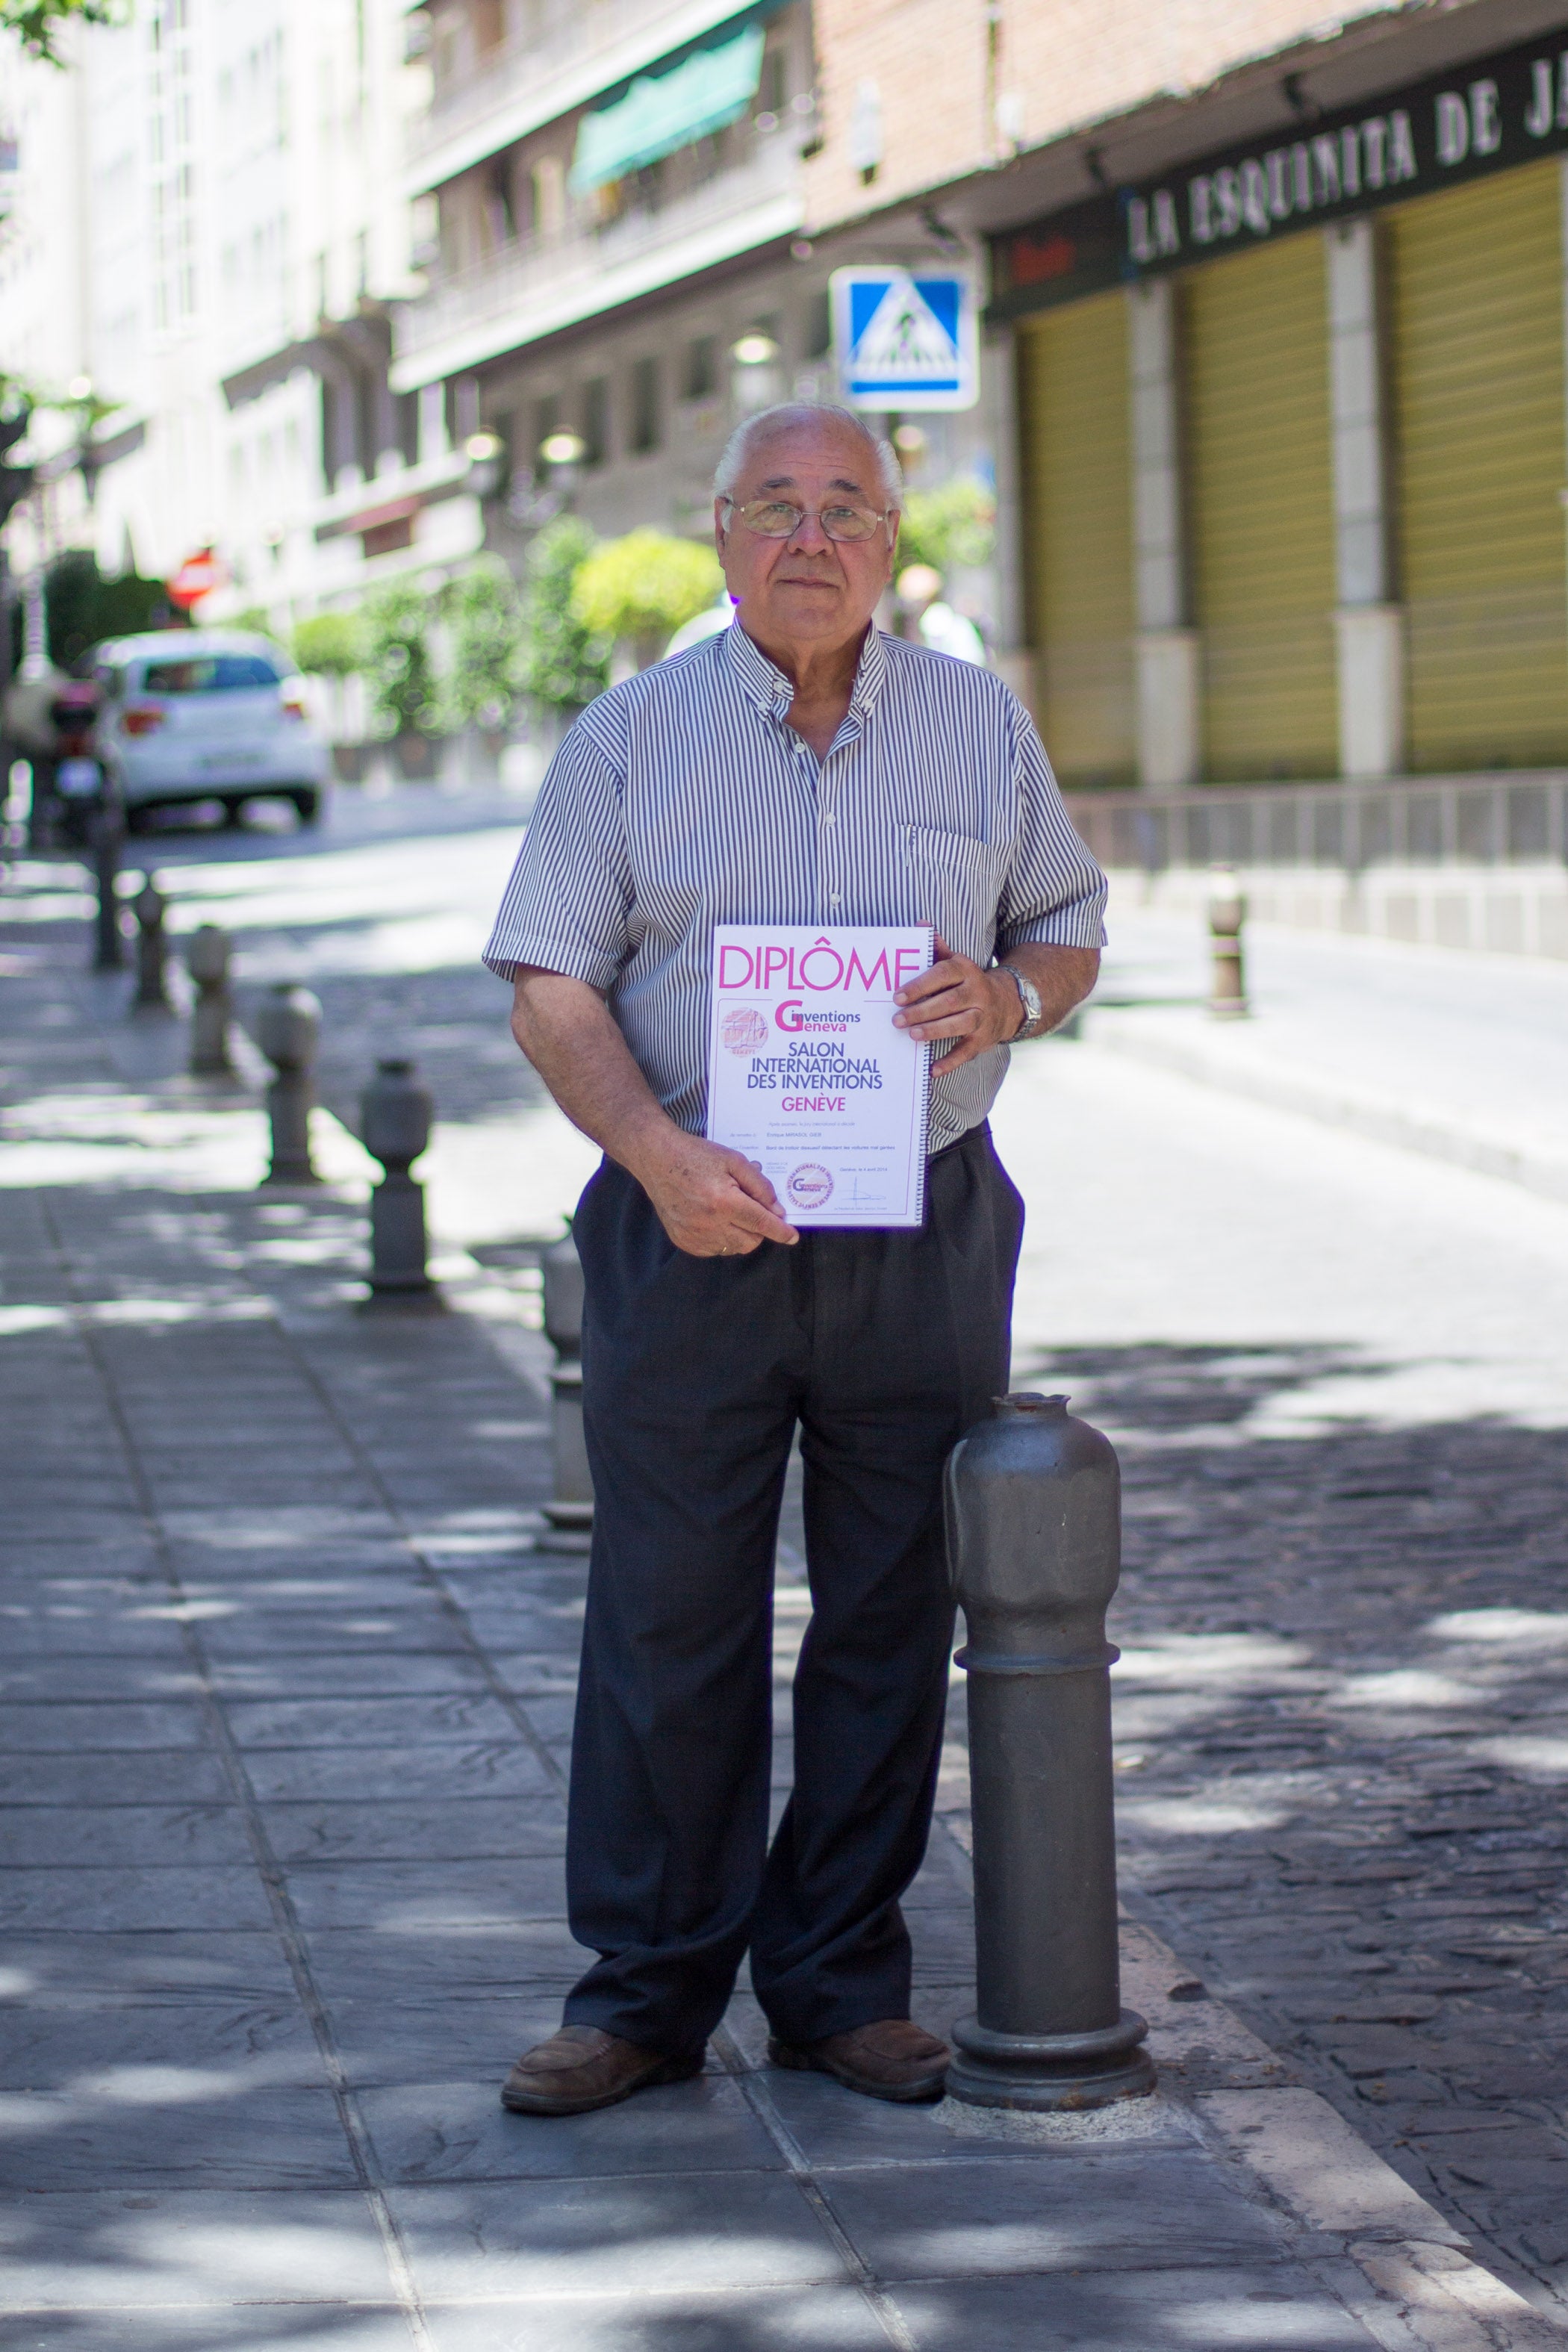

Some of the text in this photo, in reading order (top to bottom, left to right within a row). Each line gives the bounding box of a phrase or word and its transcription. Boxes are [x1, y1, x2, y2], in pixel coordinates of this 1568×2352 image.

[1128, 189, 1180, 262] LA
[1189, 109, 1417, 244] ESQUINITA
[1434, 78, 1502, 167] DE
[718, 936, 921, 992] DIPLÔME
[774, 1000, 847, 1033] Geneva
[791, 1009, 860, 1024] inventions
[788, 1042, 844, 1057] SALON
[752, 1057, 880, 1073] INTERNATIONAL
[747, 1074, 883, 1089] DES INVENTIONS
[782, 1092, 846, 1112] GENÈVE
